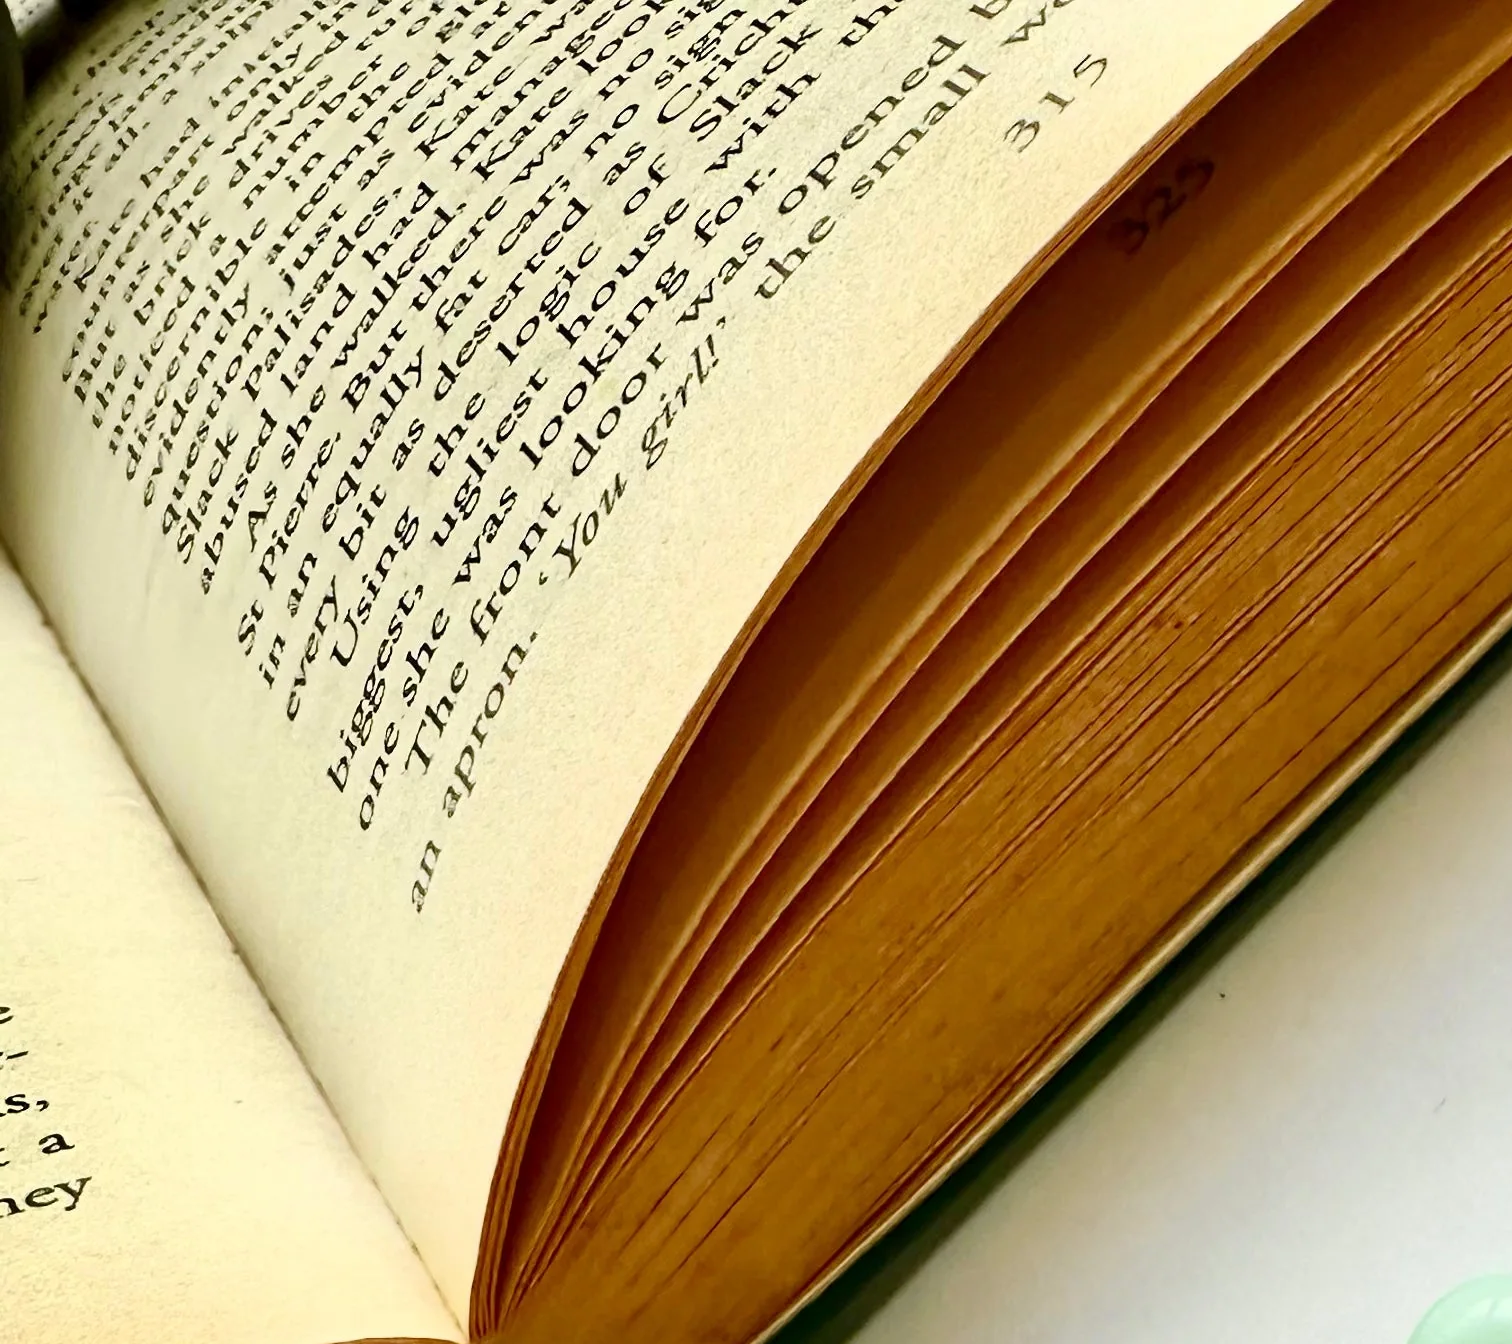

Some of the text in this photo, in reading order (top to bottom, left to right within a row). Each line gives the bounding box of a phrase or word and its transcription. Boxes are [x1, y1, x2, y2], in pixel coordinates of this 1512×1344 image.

[74, 317, 116, 405] But
[160, 174, 210, 243] she
[221, 30, 349, 155] walked
[92, 353, 127, 429] the
[133, 212, 212, 326] brick
[228, 73, 333, 189] drives
[109, 275, 196, 455] noticed
[210, 234, 226, 257] a
[243, 54, 384, 210] number
[126, 217, 268, 481] discernible
[284, 150, 326, 192] in
[346, 61, 409, 123] the
[140, 117, 200, 188] had
[209, 0, 340, 108] initiall
[143, 282, 250, 507] evidently
[264, 50, 455, 266] attempted
[162, 0, 556, 534] question; just as eviden
[176, 425, 239, 564] Slack
[241, 187, 402, 401] palisades,
[414, 64, 516, 161] Kate
[226, 41, 304, 122] only
[1003, 54, 1108, 154] 315
[201, 408, 278, 595] abused
[280, 283, 357, 398] land
[362, 181, 439, 270] had
[238, 600, 264, 656] St
[259, 431, 342, 590] Pierre.
[341, 320, 408, 413] But
[409, 195, 507, 311] there
[509, 109, 589, 185] was
[598, 48, 654, 101] no
[248, 480, 278, 552] As
[281, 385, 326, 470] she
[330, 202, 467, 368] walked,
[471, 87, 573, 184] Kate
[258, 9, 748, 689] in an equally fat car; no sign
[287, 0, 808, 722] every bit as deserted as Crich
[326, 584, 424, 793] biggest,
[430, 367, 550, 547] ugliest
[556, 197, 690, 349] house
[704, 72, 822, 174] with
[330, 23, 823, 667] Using the logic of Slack
[359, 166, 778, 831] one she was looking for.
[400, 661, 470, 776] The
[470, 491, 562, 647] front
[572, 342, 670, 477] door
[675, 231, 765, 326] was
[778, 35, 968, 215] opened
[411, 840, 443, 914] an
[442, 631, 539, 818] apron.
[754, 215, 837, 300] the
[851, 64, 992, 200] small
[38, 1133, 76, 1155] a
